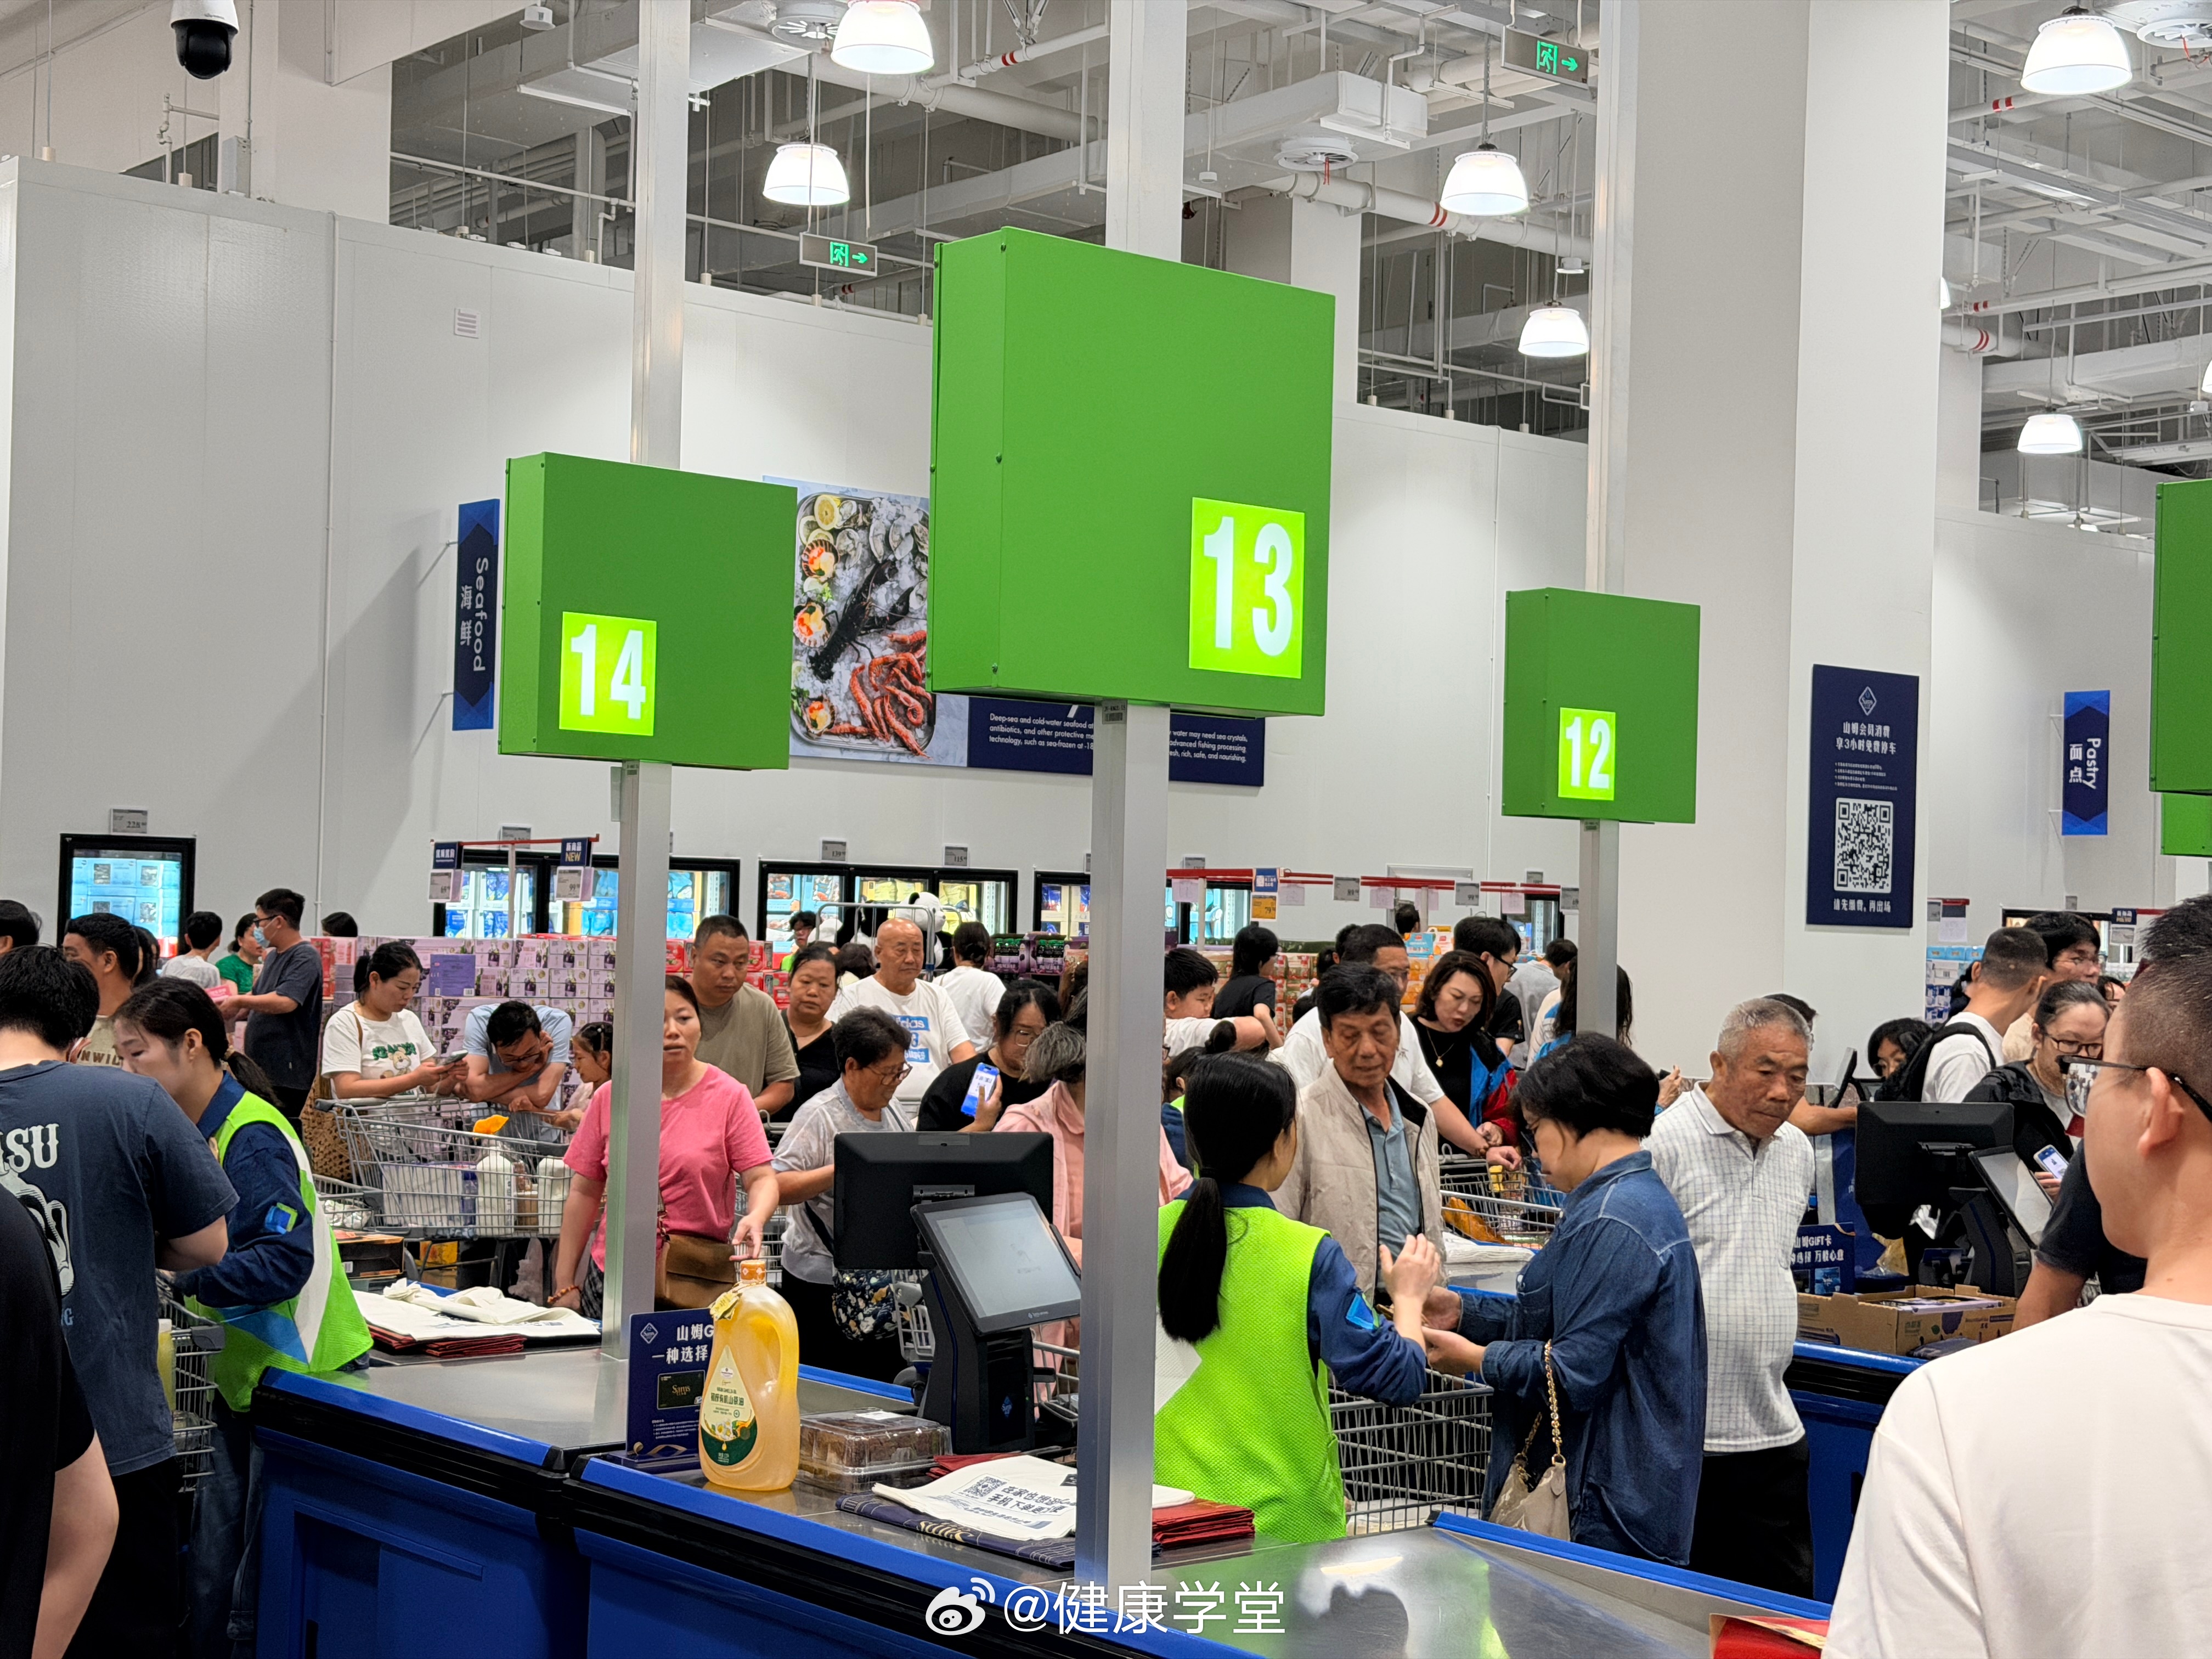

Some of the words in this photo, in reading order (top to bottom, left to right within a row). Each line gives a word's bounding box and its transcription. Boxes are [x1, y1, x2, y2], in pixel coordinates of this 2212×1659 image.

[1204, 515, 1293, 656] 13
[460, 585, 472, 646] 海鲜
[473, 557, 489, 672] Seafood
[571, 624, 646, 719] 14
[990, 713, 1018, 723] Deep-sea
[1032, 717, 1062, 726] cold-water
[1063, 720, 1087, 729] seafood
[1843, 721, 1891, 738] 山姆会员消费
[989, 735, 1023, 746] technology,
[1046, 740, 1076, 749] sea-frozen
[990, 725, 1022, 734] antibiotics,
[1054, 730, 1084, 738] protective
[1198, 741, 1216, 751] fishing
[1566, 716, 1610, 789] 12
[1836, 737, 1897, 755] 享3小时免费停车
[2069, 743, 2083, 783] 面点
[2083, 738, 2102, 789] Pastry
[565, 851, 582, 862] NEW
[0, 1123, 59, 1173] SU
[676, 1323, 714, 1341] 山姆G
[651, 1344, 708, 1364] 一种选择
